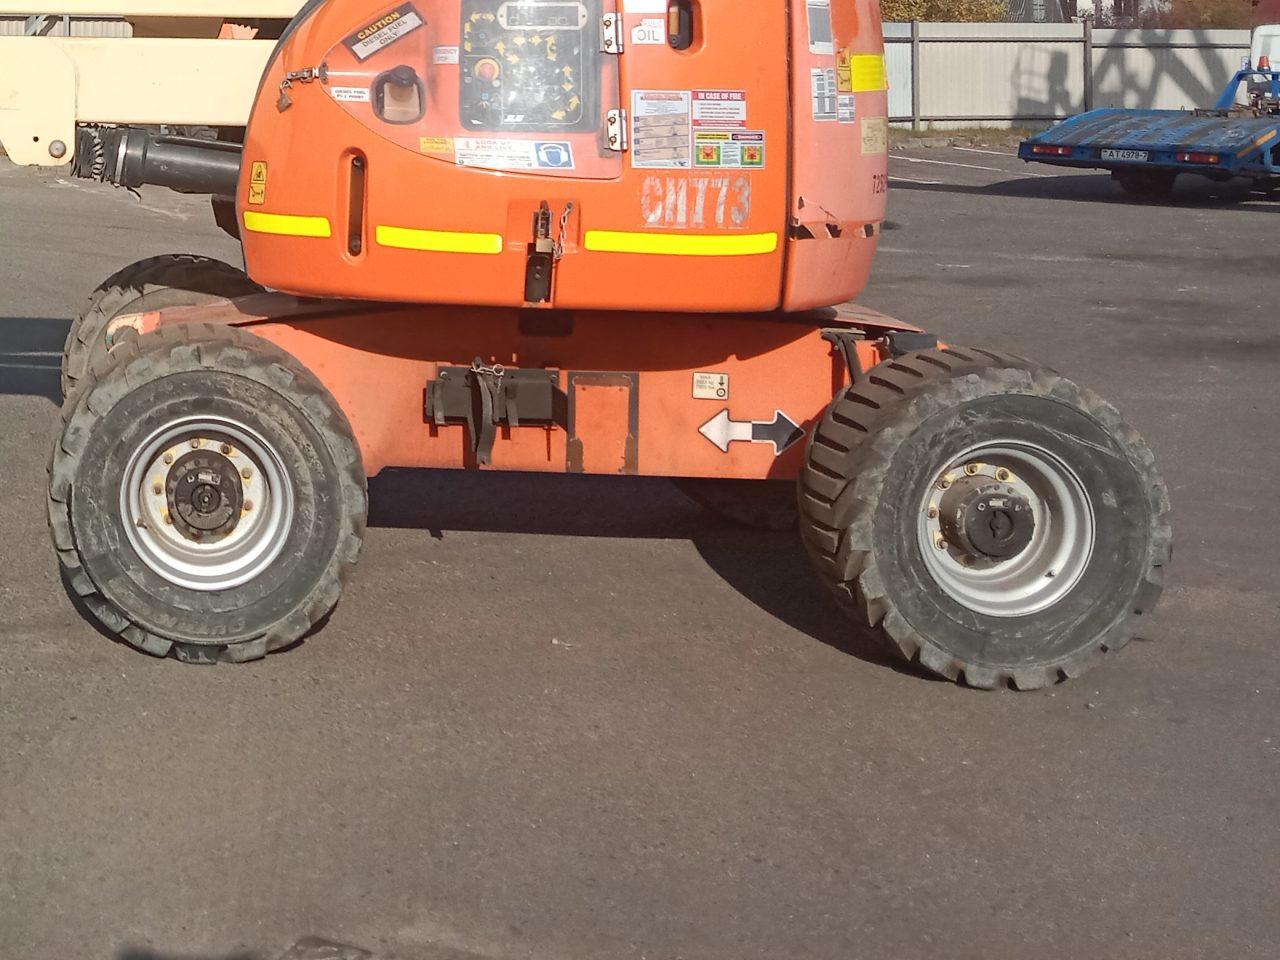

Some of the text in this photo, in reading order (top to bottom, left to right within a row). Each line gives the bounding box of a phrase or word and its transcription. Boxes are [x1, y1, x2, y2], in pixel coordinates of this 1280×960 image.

[358, 11, 400, 40] CAUTION
[362, 19, 408, 47] DIESEL FUEL
[379, 31, 400, 45] ONLY
[637, 29, 660, 41] OIL
[698, 92, 742, 100] IN CASE OF FIRE
